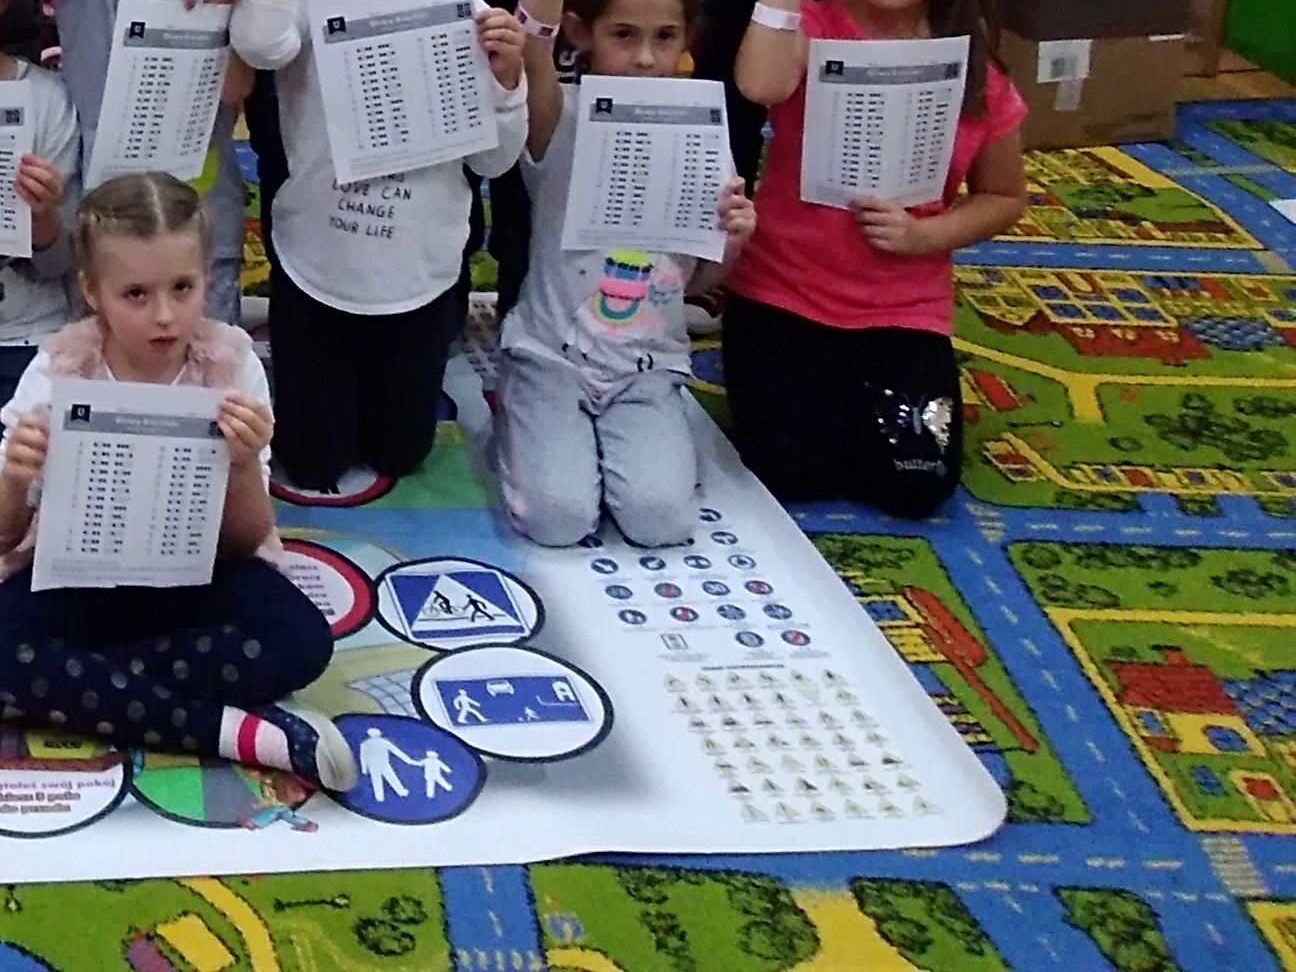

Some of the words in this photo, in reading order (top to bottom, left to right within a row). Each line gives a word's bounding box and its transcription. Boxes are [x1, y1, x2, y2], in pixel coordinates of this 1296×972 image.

[333, 178, 370, 196] LOVE
[381, 186, 412, 200] CAN
[338, 199, 395, 218] CHANGE
[329, 216, 359, 234] YOUR
[366, 225, 394, 239] LIFE
[41, 779, 73, 790] swój
[77, 778, 116, 790] pokój
